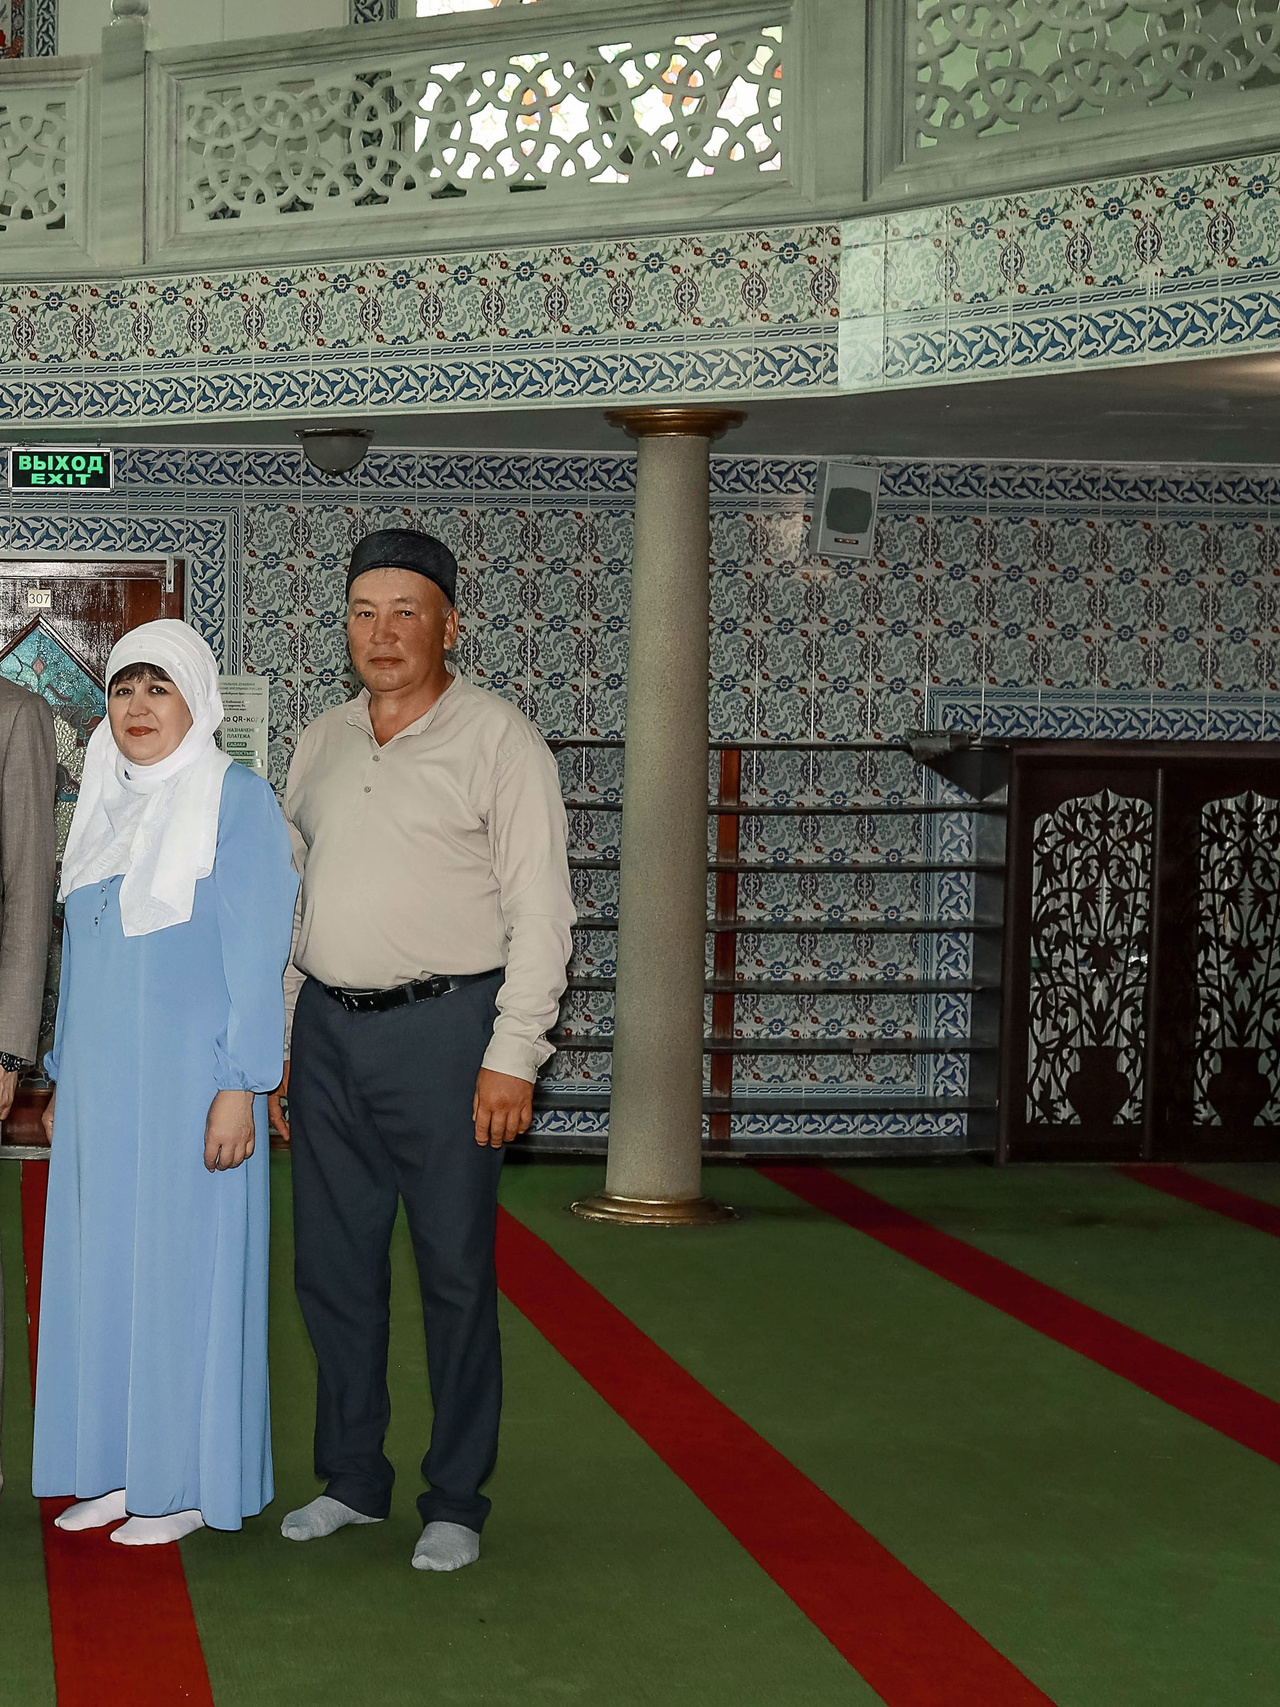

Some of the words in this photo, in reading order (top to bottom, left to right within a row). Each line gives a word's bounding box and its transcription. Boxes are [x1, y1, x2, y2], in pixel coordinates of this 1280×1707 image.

[18, 455, 104, 474] ВЫХОД
[31, 473, 91, 485] EXIT
[28, 593, 50, 604] 307
